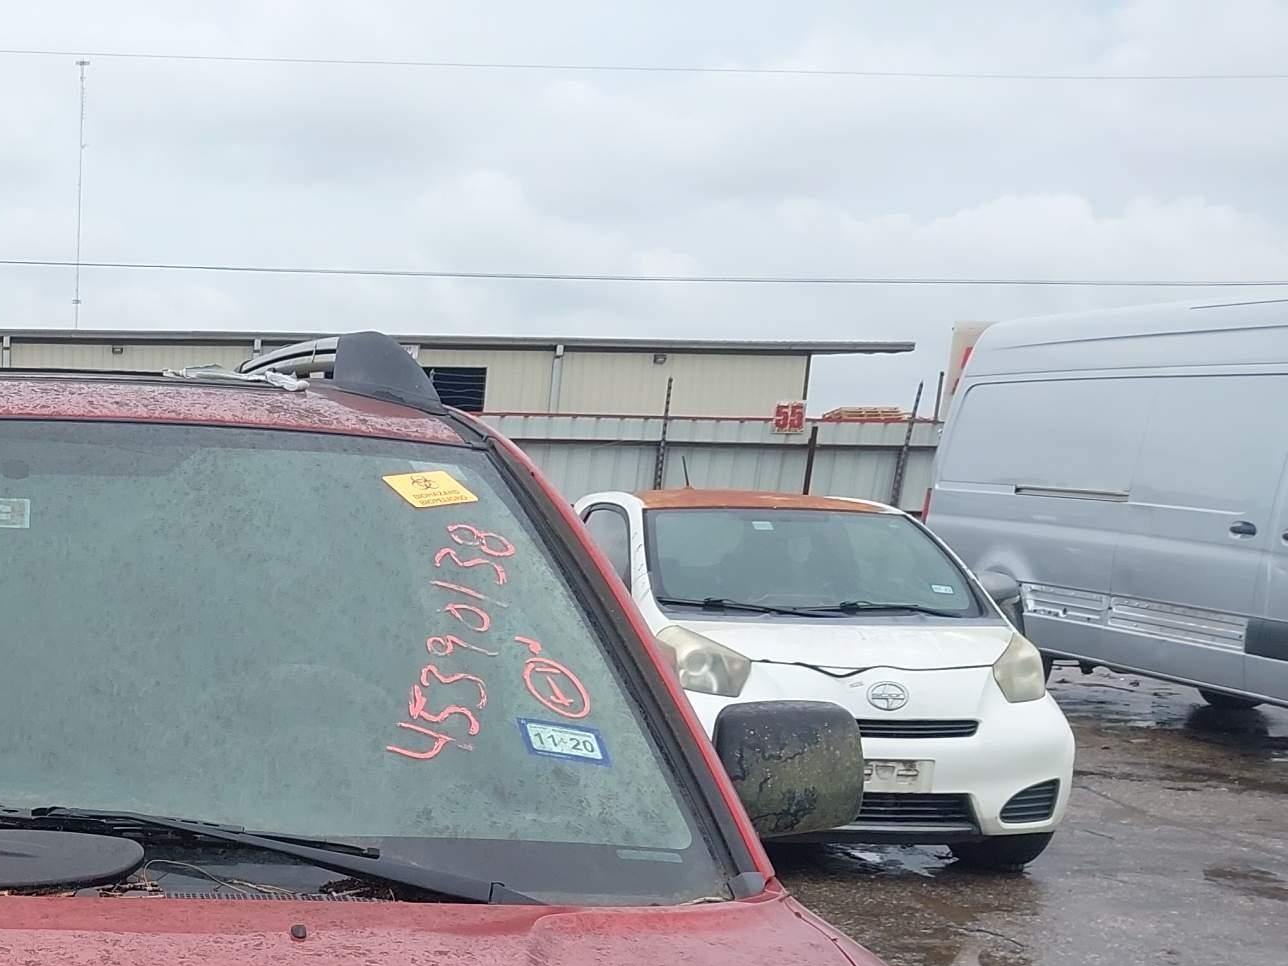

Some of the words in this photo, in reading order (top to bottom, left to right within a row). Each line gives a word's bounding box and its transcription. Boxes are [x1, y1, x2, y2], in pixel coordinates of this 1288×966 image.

[775, 405, 804, 429] 55
[386, 523, 516, 759] 45390138
[569, 737, 595, 753] 20
